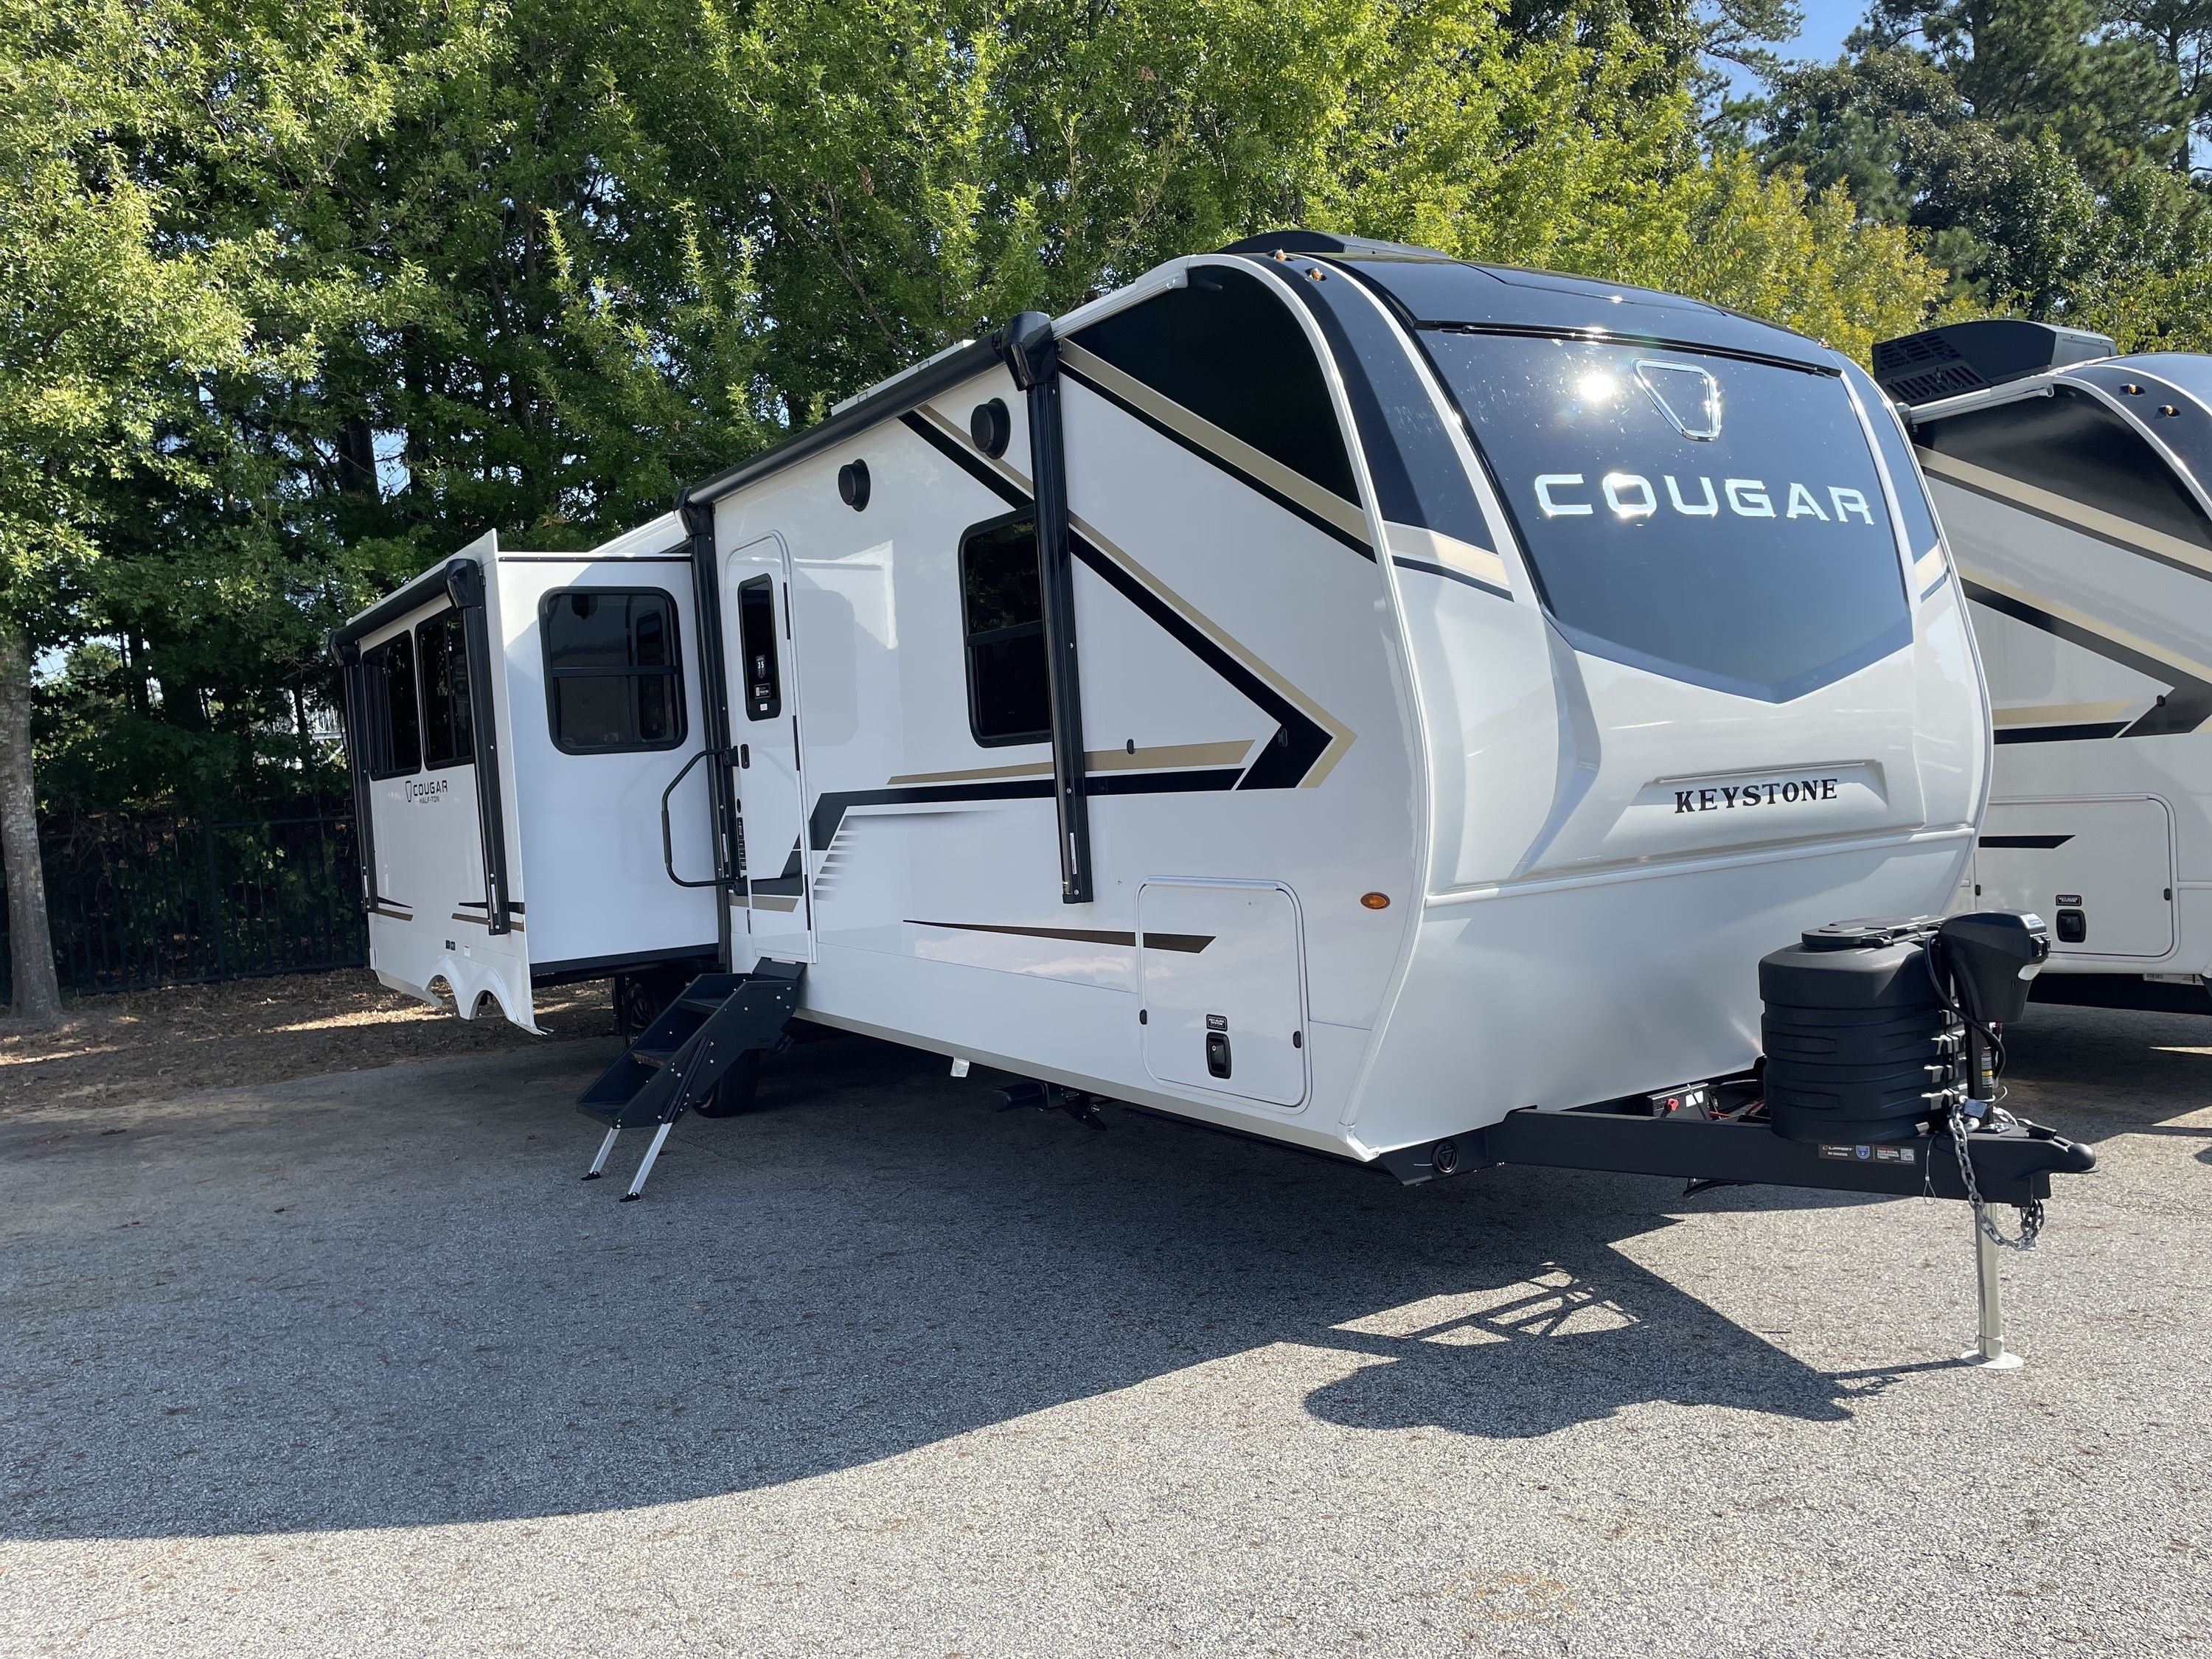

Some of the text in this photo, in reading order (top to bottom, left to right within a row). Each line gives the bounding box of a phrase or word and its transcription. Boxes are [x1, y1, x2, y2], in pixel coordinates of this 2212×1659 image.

[1534, 473, 1875, 526] COUGAR
[413, 780, 448, 796] COUGAR
[419, 796, 440, 804] HALF-TON
[1674, 779, 1838, 814] KEYSTONE
